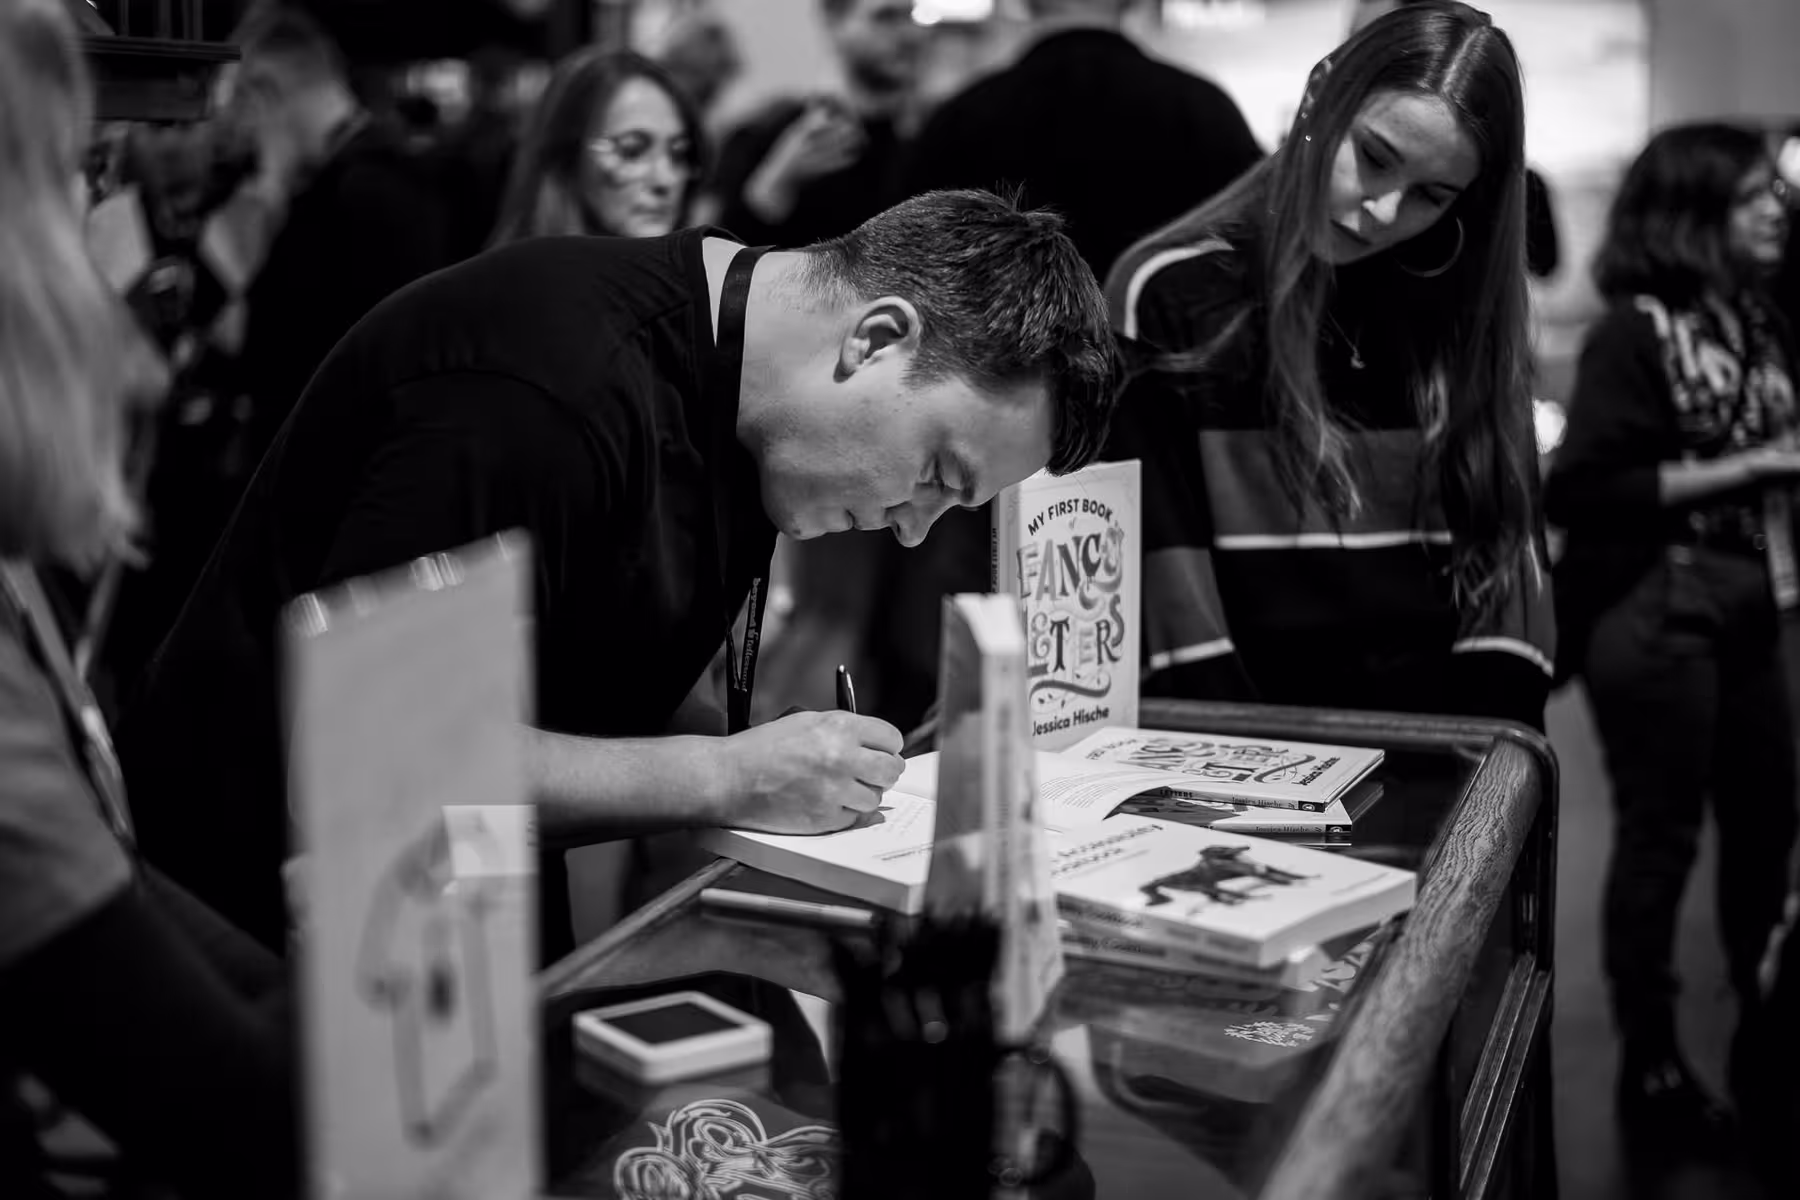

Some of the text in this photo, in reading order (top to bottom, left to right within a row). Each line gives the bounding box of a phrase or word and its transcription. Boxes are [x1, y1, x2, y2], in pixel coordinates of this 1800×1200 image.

[1028, 499, 1113, 536] MY FIRST BOOK
[1032, 704, 1110, 737] Jessica Hische
